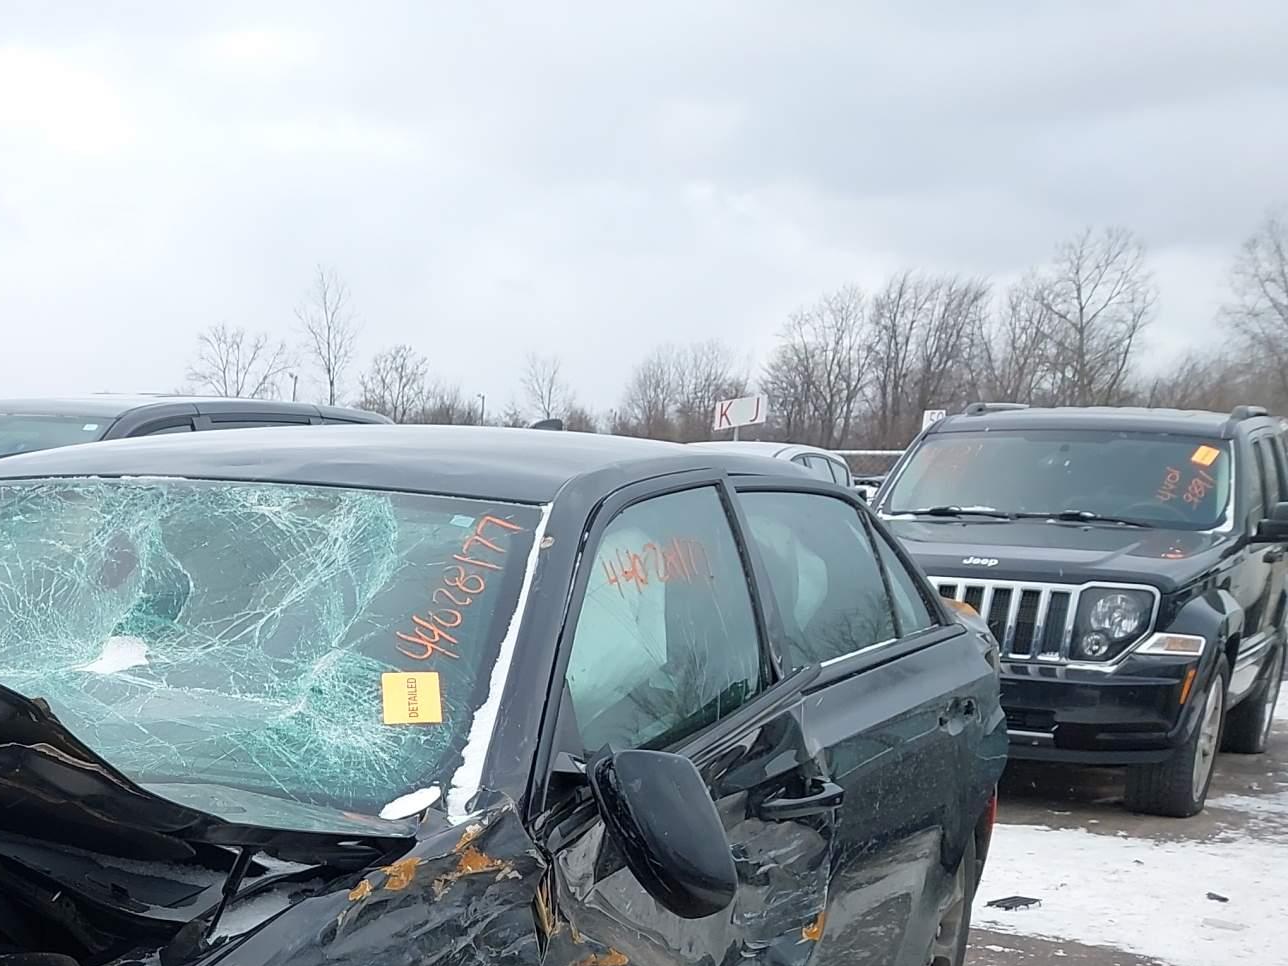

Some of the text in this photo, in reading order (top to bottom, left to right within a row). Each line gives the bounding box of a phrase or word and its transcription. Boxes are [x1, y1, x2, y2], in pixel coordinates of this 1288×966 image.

[719, 397, 760, 428] K J
[962, 556, 999, 567] Jeep
[396, 515, 529, 660] 44028177
[407, 677, 420, 718] DETAILED
